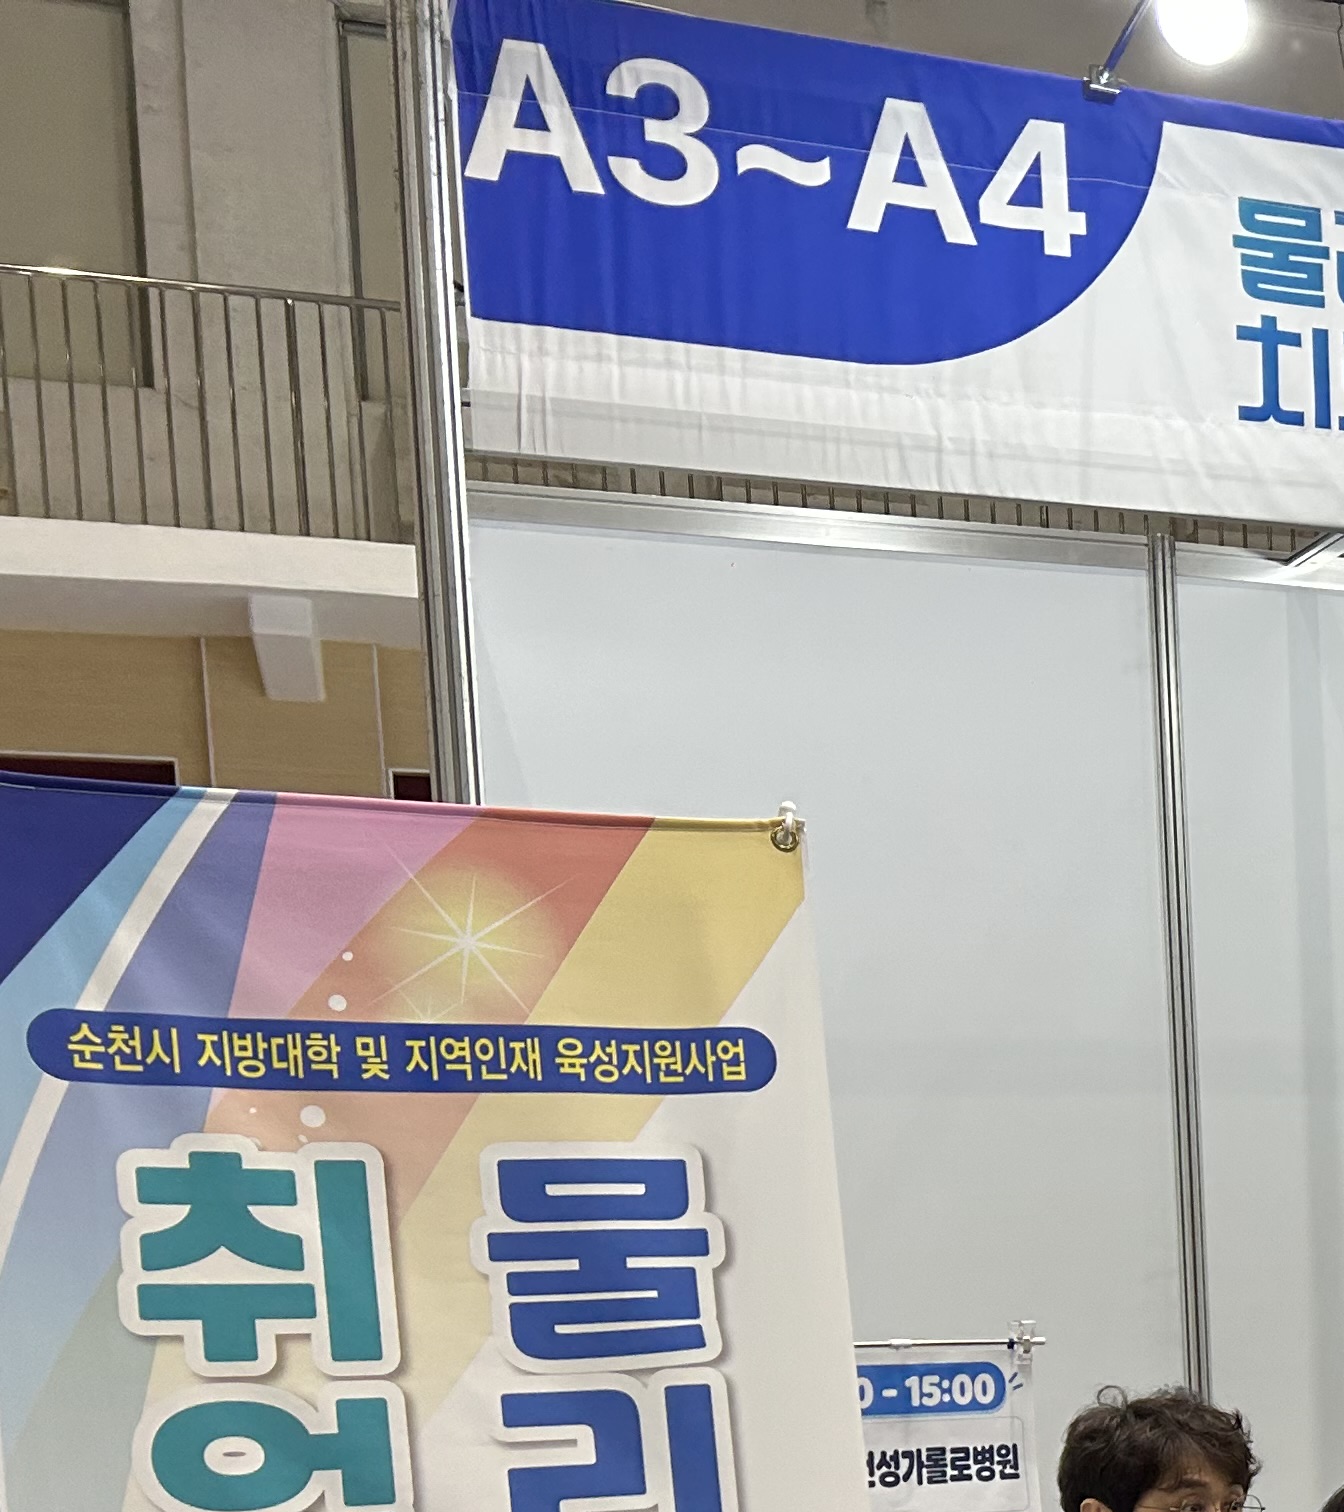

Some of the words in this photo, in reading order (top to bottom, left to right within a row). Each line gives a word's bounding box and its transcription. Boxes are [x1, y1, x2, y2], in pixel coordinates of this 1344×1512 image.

[463, 37, 1088, 259] A3~A4
[67, 1021, 180, 1072] 순천시
[197, 1031, 342, 1080] 지방대학
[354, 1036, 391, 1081] 및
[405, 1037, 544, 1083] 지역인재
[554, 1038, 749, 1085] 육성지원사업
[905, 1372, 996, 1407] 15:00
